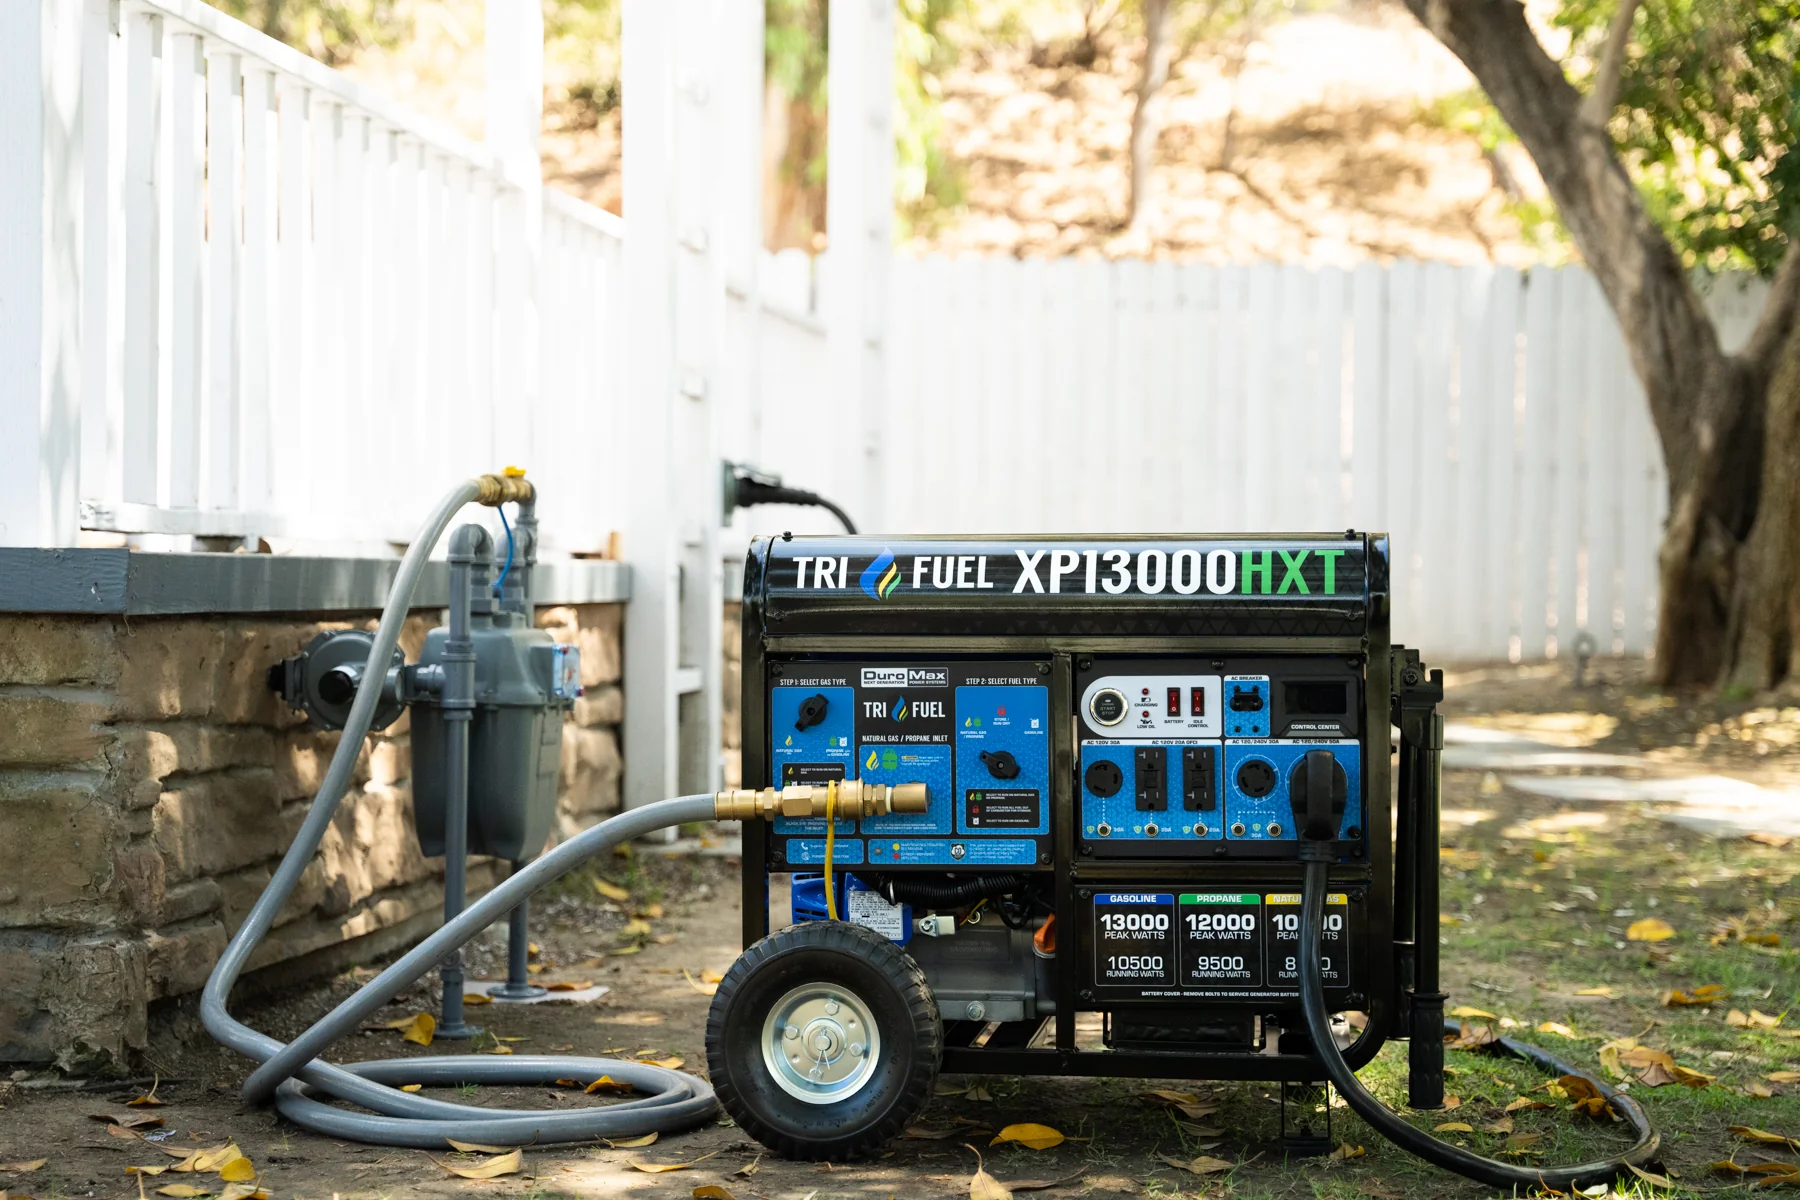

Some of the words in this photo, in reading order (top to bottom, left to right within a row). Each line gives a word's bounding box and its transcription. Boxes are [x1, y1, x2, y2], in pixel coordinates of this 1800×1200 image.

[792, 556, 848, 589] TRI
[912, 556, 994, 589] FUEL
[1011, 549, 1345, 595] XP13000HXT
[780, 678, 794, 686] STEP
[794, 678, 799, 686] 1:
[800, 678, 819, 686] SELECT
[820, 678, 831, 686] GAS
[832, 678, 846, 686] TYPE
[863, 702, 886, 718] TRI
[912, 702, 946, 718] FUEL
[1100, 914, 1169, 930] 13000
[1186, 914, 1255, 930] 12000
[1272, 914, 1342, 930] 100
[1105, 931, 1129, 940] PEAK
[1132, 931, 1165, 940] WATTS
[1190, 932, 1214, 940] PEAK
[1218, 932, 1251, 940] WATTS
[1108, 956, 1163, 970] 10500
[1198, 956, 1243, 970] 9500
[1285, 956, 1331, 970] 80
[866, 1089, 885, 1110] NYLON
